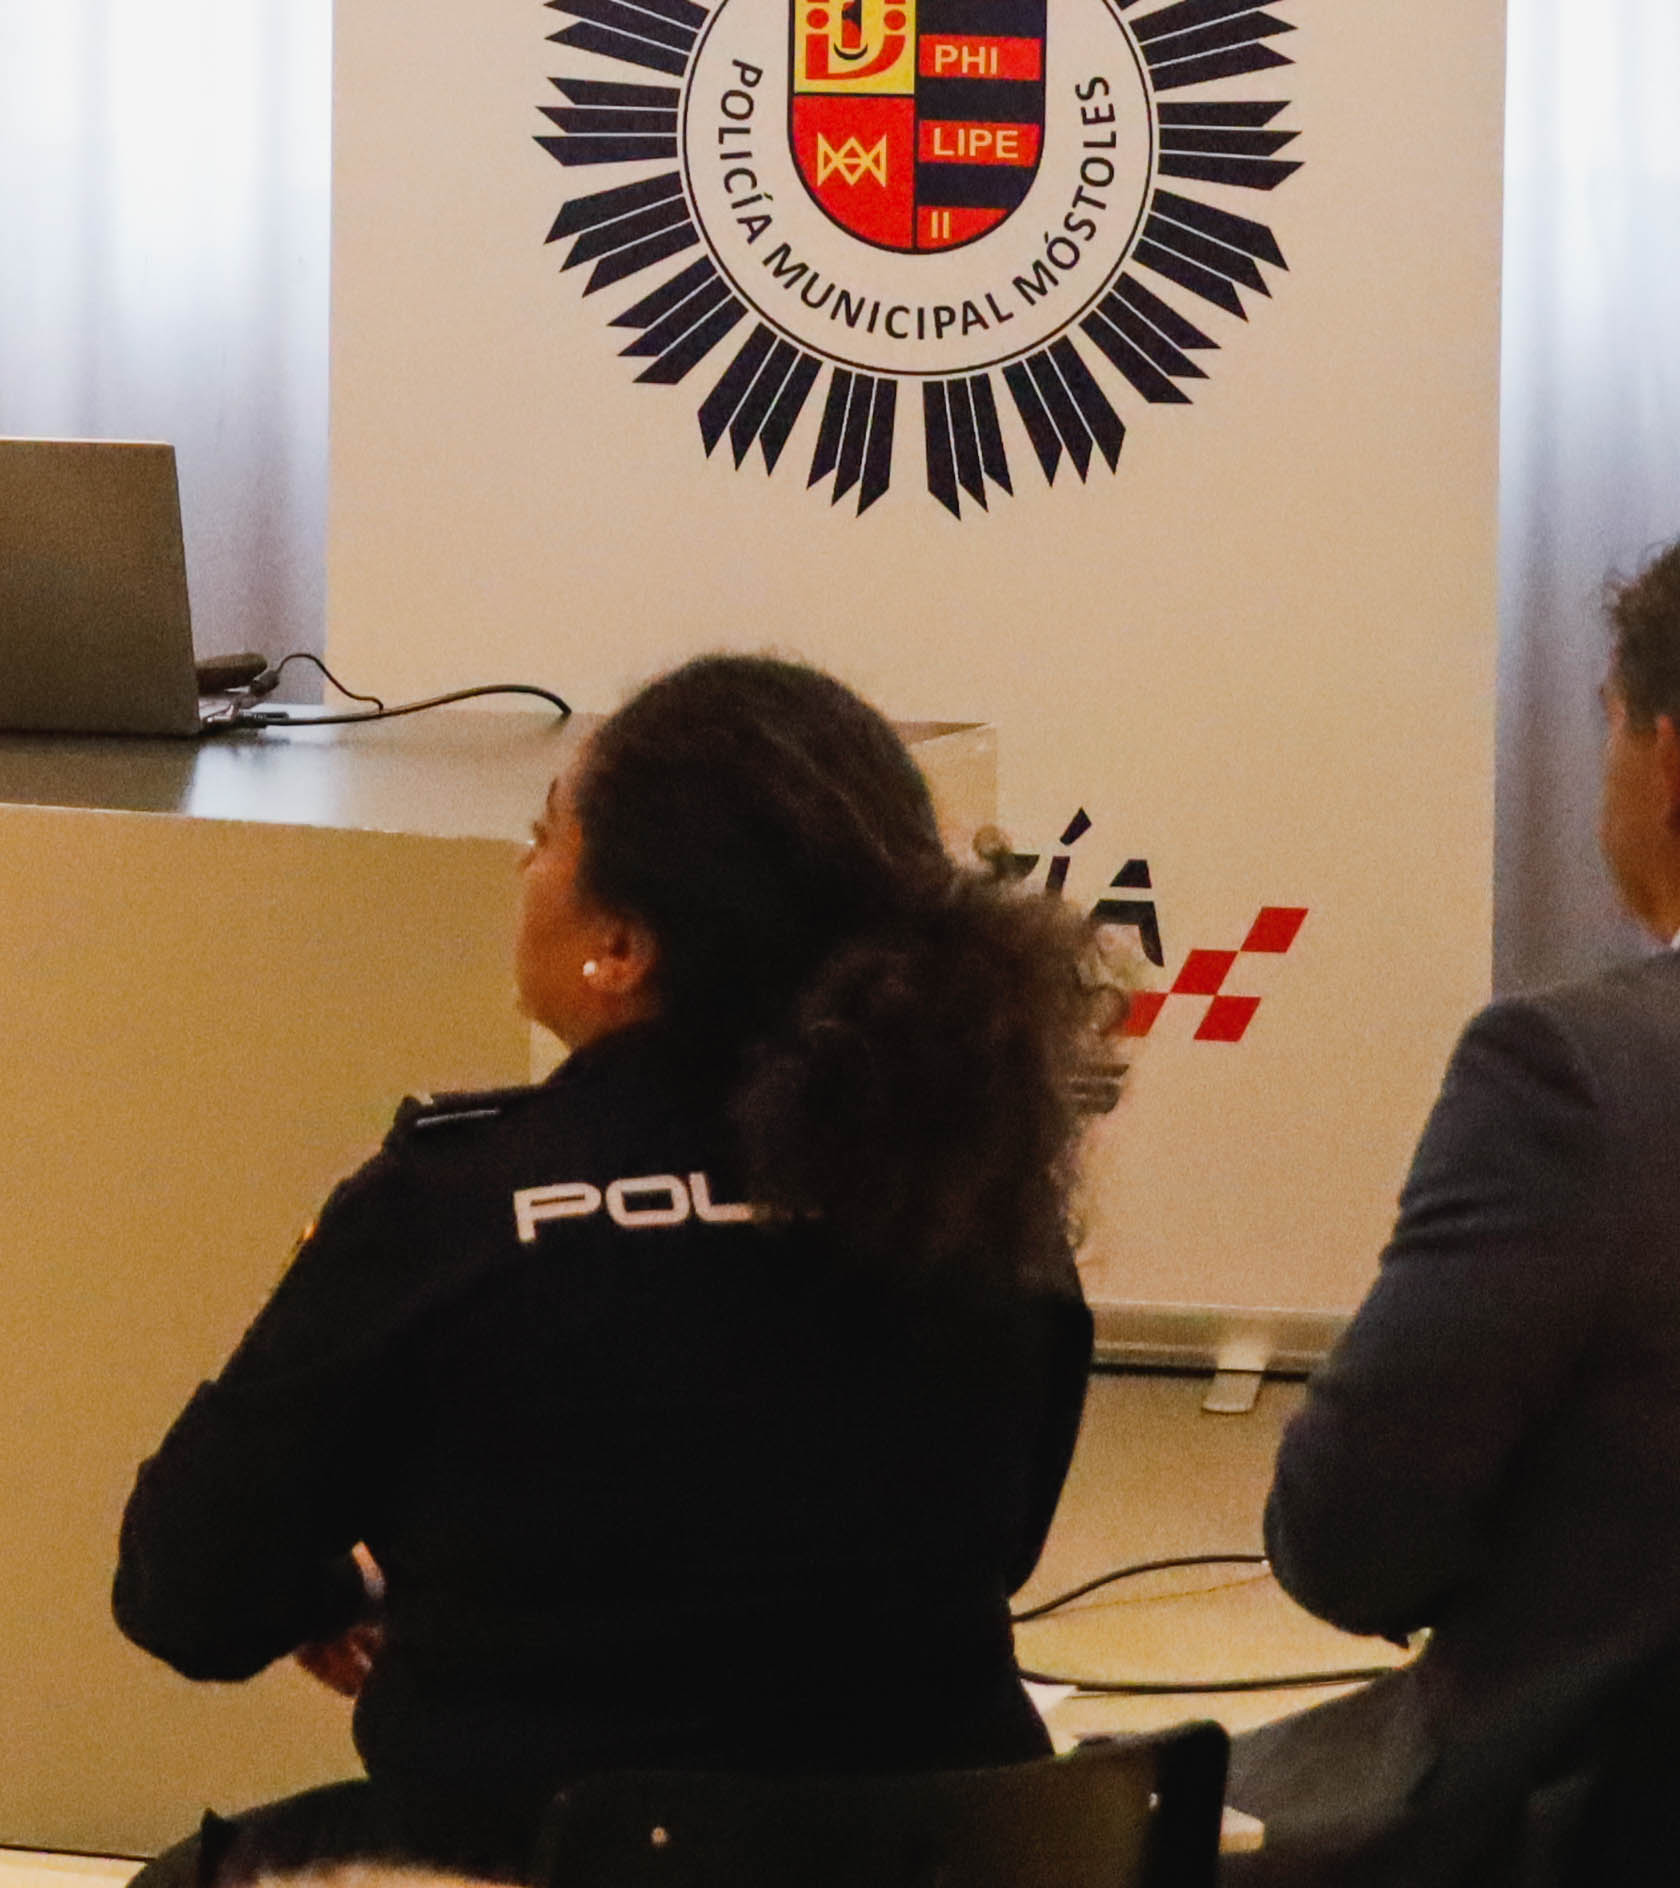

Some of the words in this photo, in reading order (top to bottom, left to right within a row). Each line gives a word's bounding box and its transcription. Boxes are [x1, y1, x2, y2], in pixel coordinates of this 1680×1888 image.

[934, 44, 999, 76] PHI
[933, 127, 1019, 159] LIPE
[717, 58, 774, 244] POLICÍA
[762, 242, 1015, 340] MUNICIPAL
[1011, 75, 1118, 306] MÓSTOLES
[513, 1171, 755, 1243] POL
